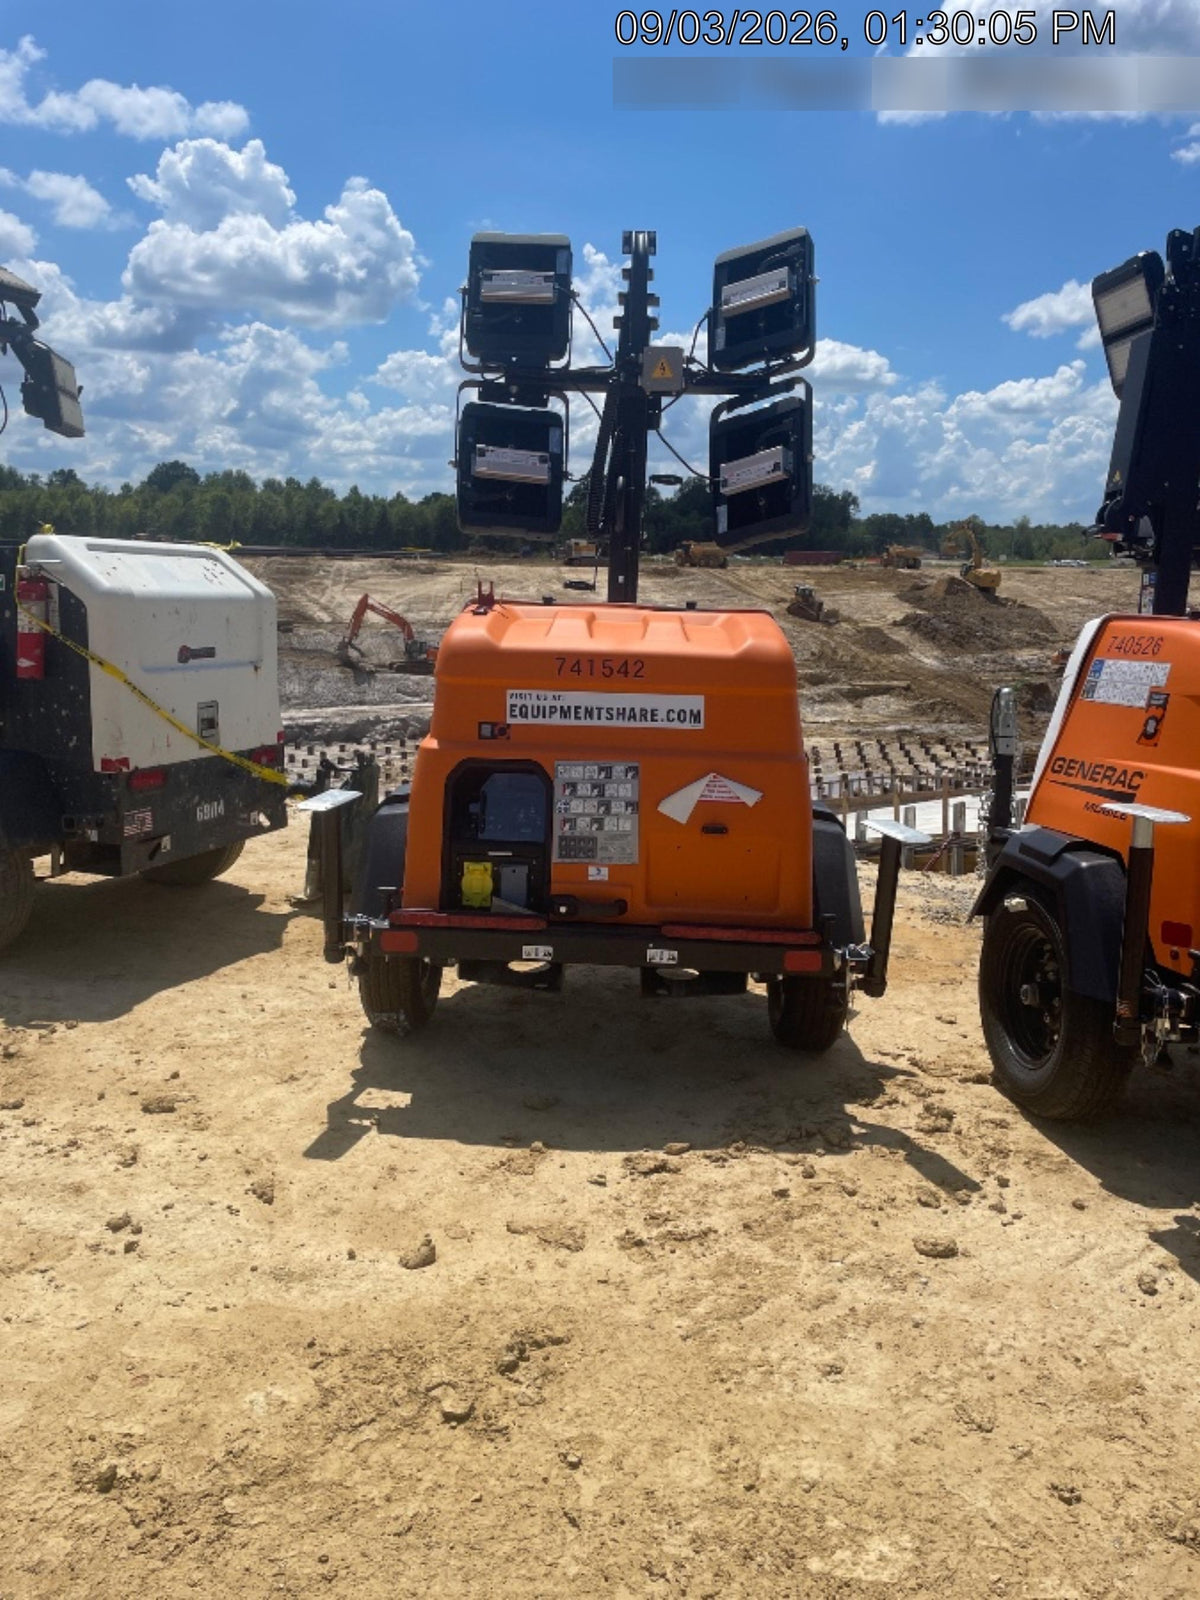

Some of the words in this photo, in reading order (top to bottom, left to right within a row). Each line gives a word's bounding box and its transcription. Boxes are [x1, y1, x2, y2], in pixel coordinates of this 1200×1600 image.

[1106, 636, 1164, 656] 740526
[555, 657, 645, 678] 741542
[509, 703, 702, 725] EQUIPMENTSHARE.COM
[1050, 756, 1144, 790] GENERAC
